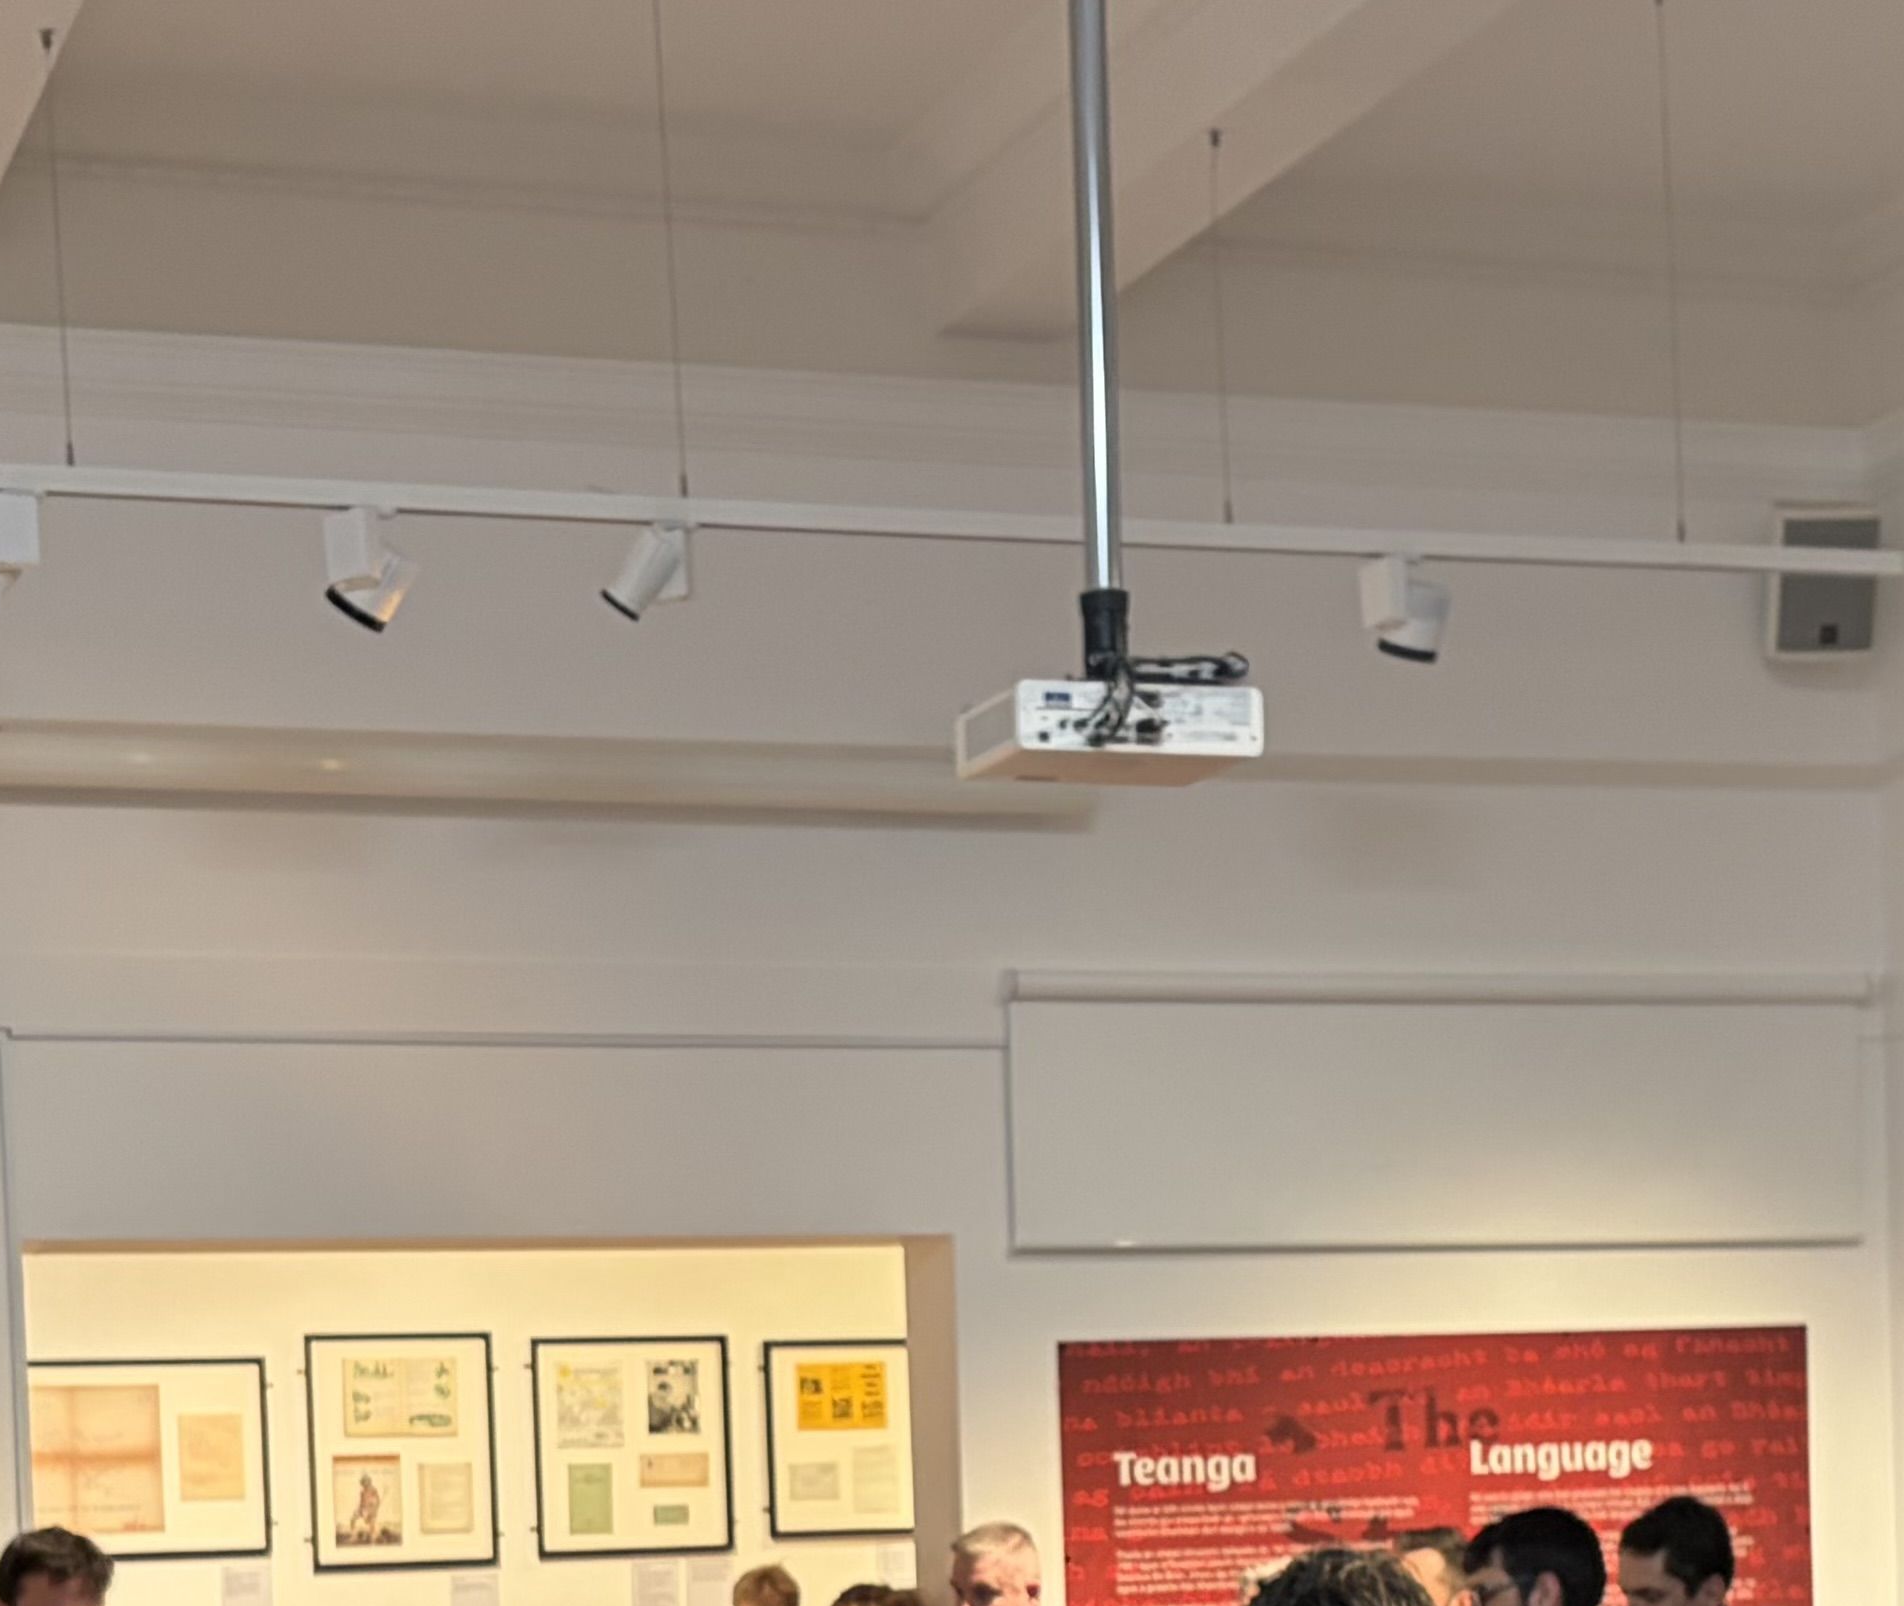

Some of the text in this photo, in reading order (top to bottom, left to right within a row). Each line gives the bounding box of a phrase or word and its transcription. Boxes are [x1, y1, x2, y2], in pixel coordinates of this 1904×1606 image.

[1368, 1384, 1501, 1451] The
[1113, 1450, 1257, 1492] Teanga
[1469, 1438, 1654, 1481] Language
